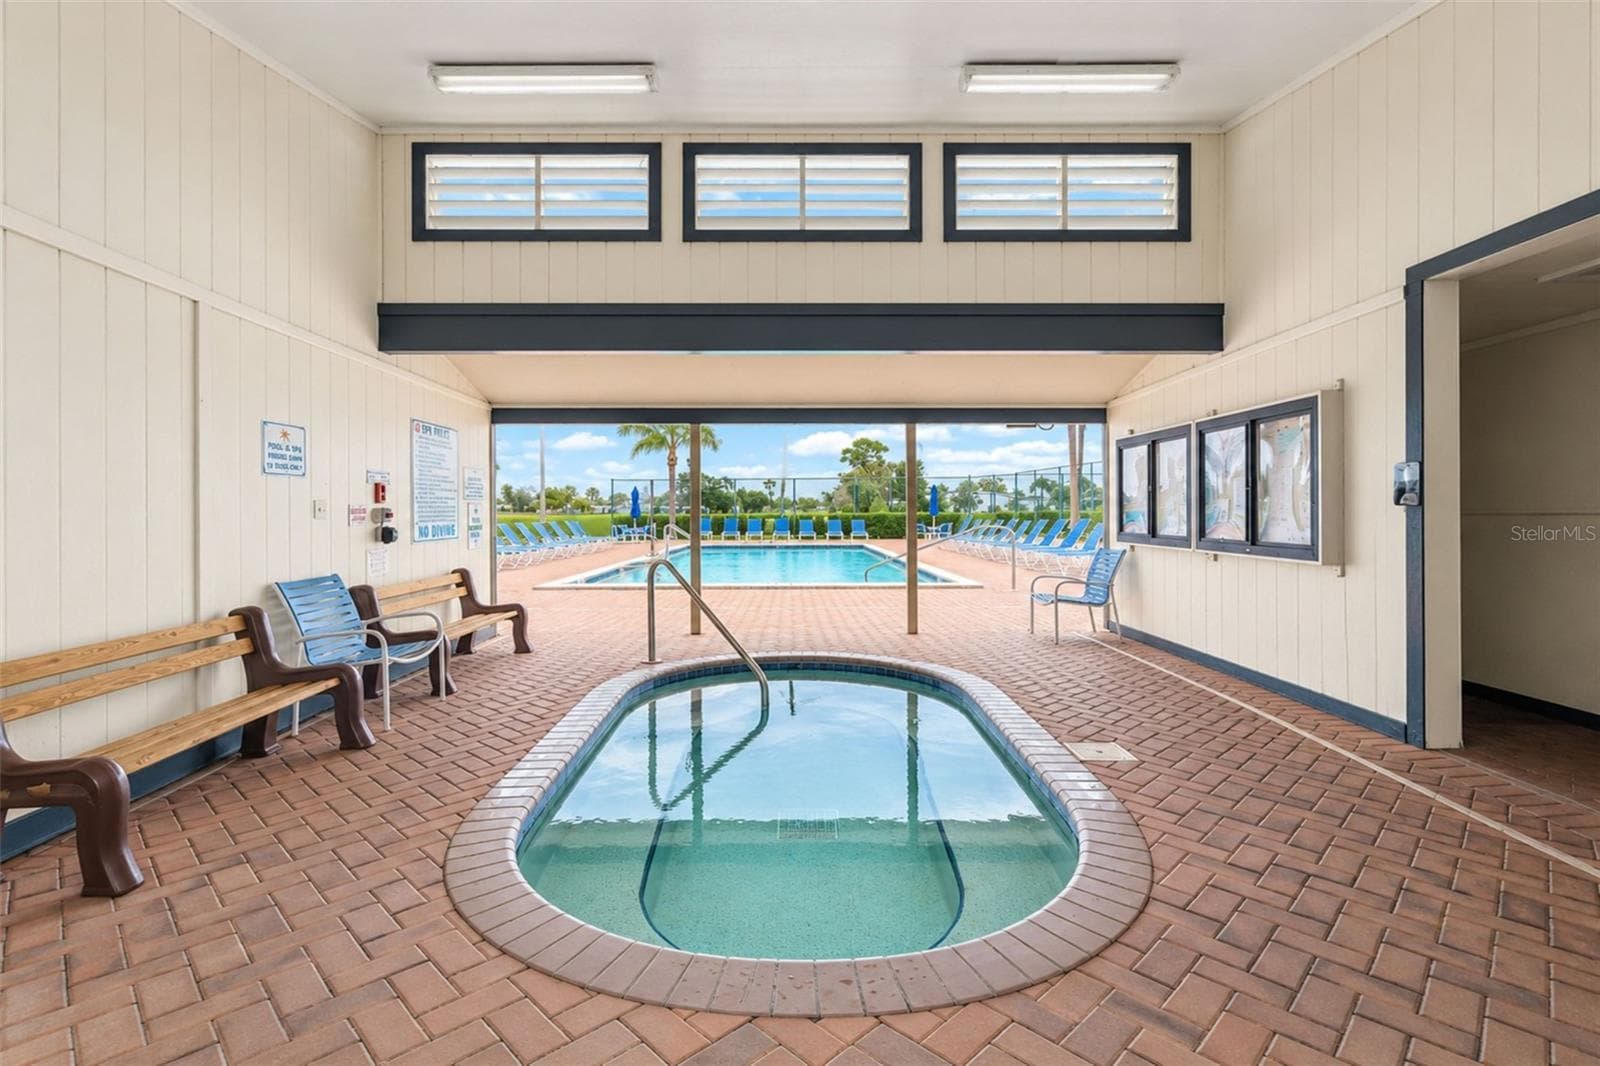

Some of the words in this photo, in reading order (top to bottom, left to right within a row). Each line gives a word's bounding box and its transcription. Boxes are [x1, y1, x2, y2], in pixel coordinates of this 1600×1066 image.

[267, 441, 283, 451] POOL
[418, 525, 429, 538] NO
[431, 524, 456, 537] DIVING
